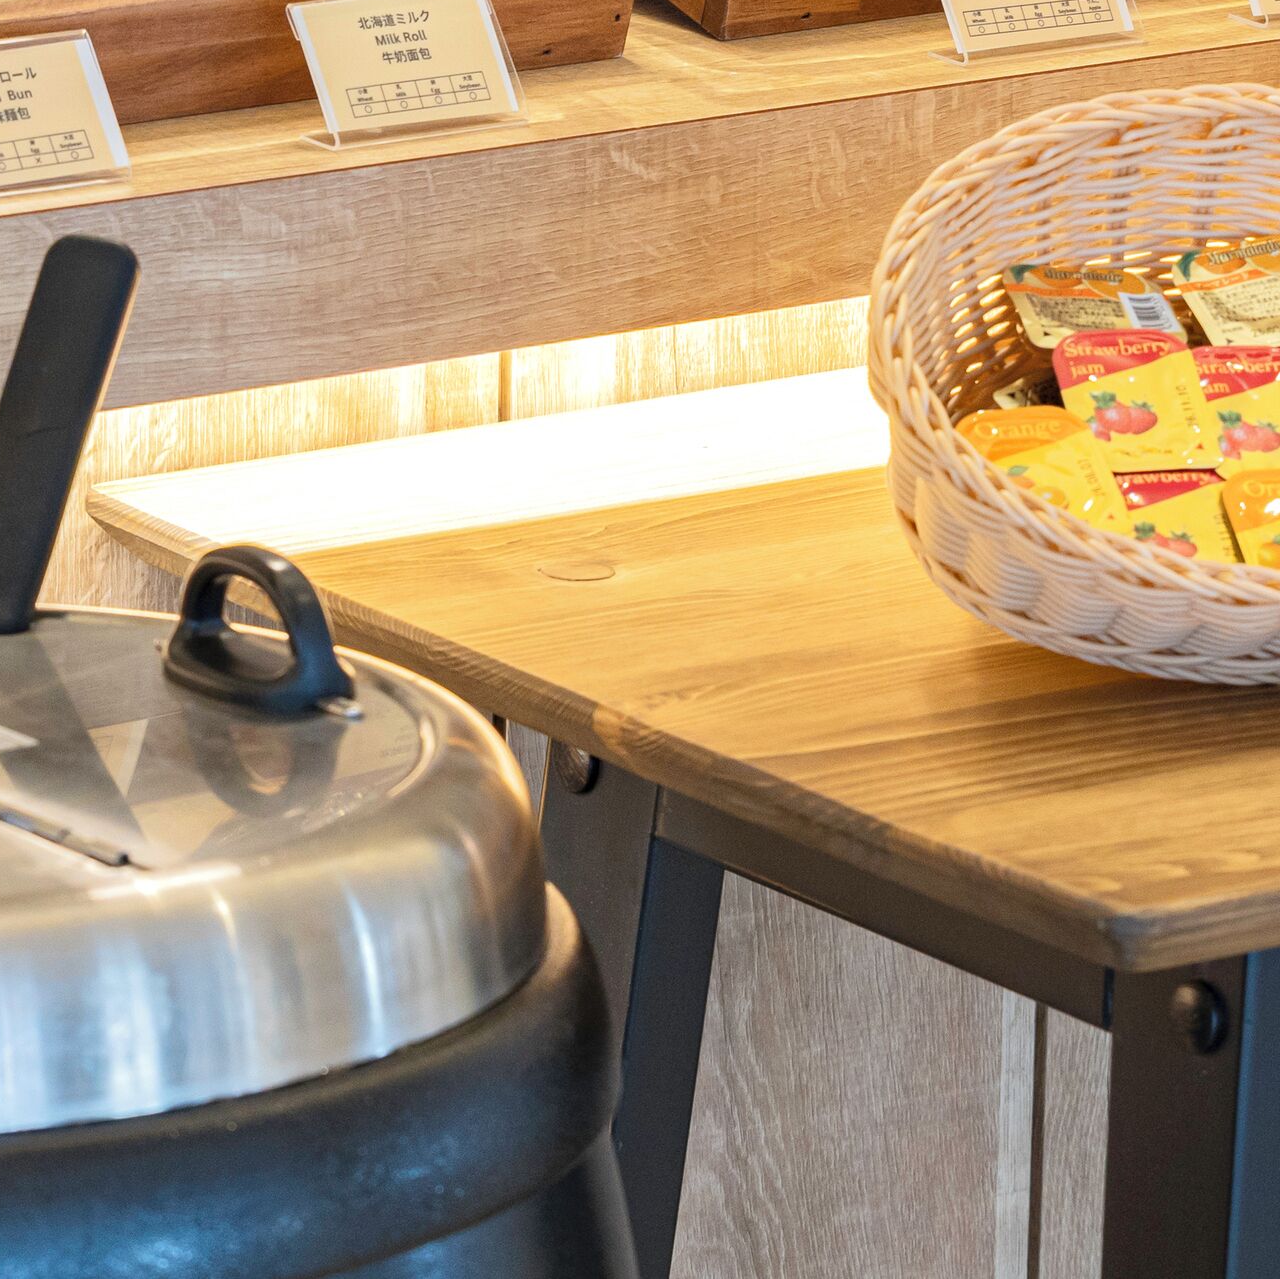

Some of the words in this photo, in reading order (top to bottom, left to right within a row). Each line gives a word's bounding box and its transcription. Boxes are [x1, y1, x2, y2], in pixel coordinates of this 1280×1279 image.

[358, 9, 431, 31] 北海道ミルク
[375, 33, 401, 47] Milk
[404, 30, 428, 43] Roll
[381, 47, 432, 65] 牛奶面包
[7, 88, 33, 101] Bun
[1063, 337, 1171, 358] Strawberry
[1070, 362, 1105, 379] jam
[1202, 380, 1230, 394] am
[974, 419, 1062, 440] Orange
